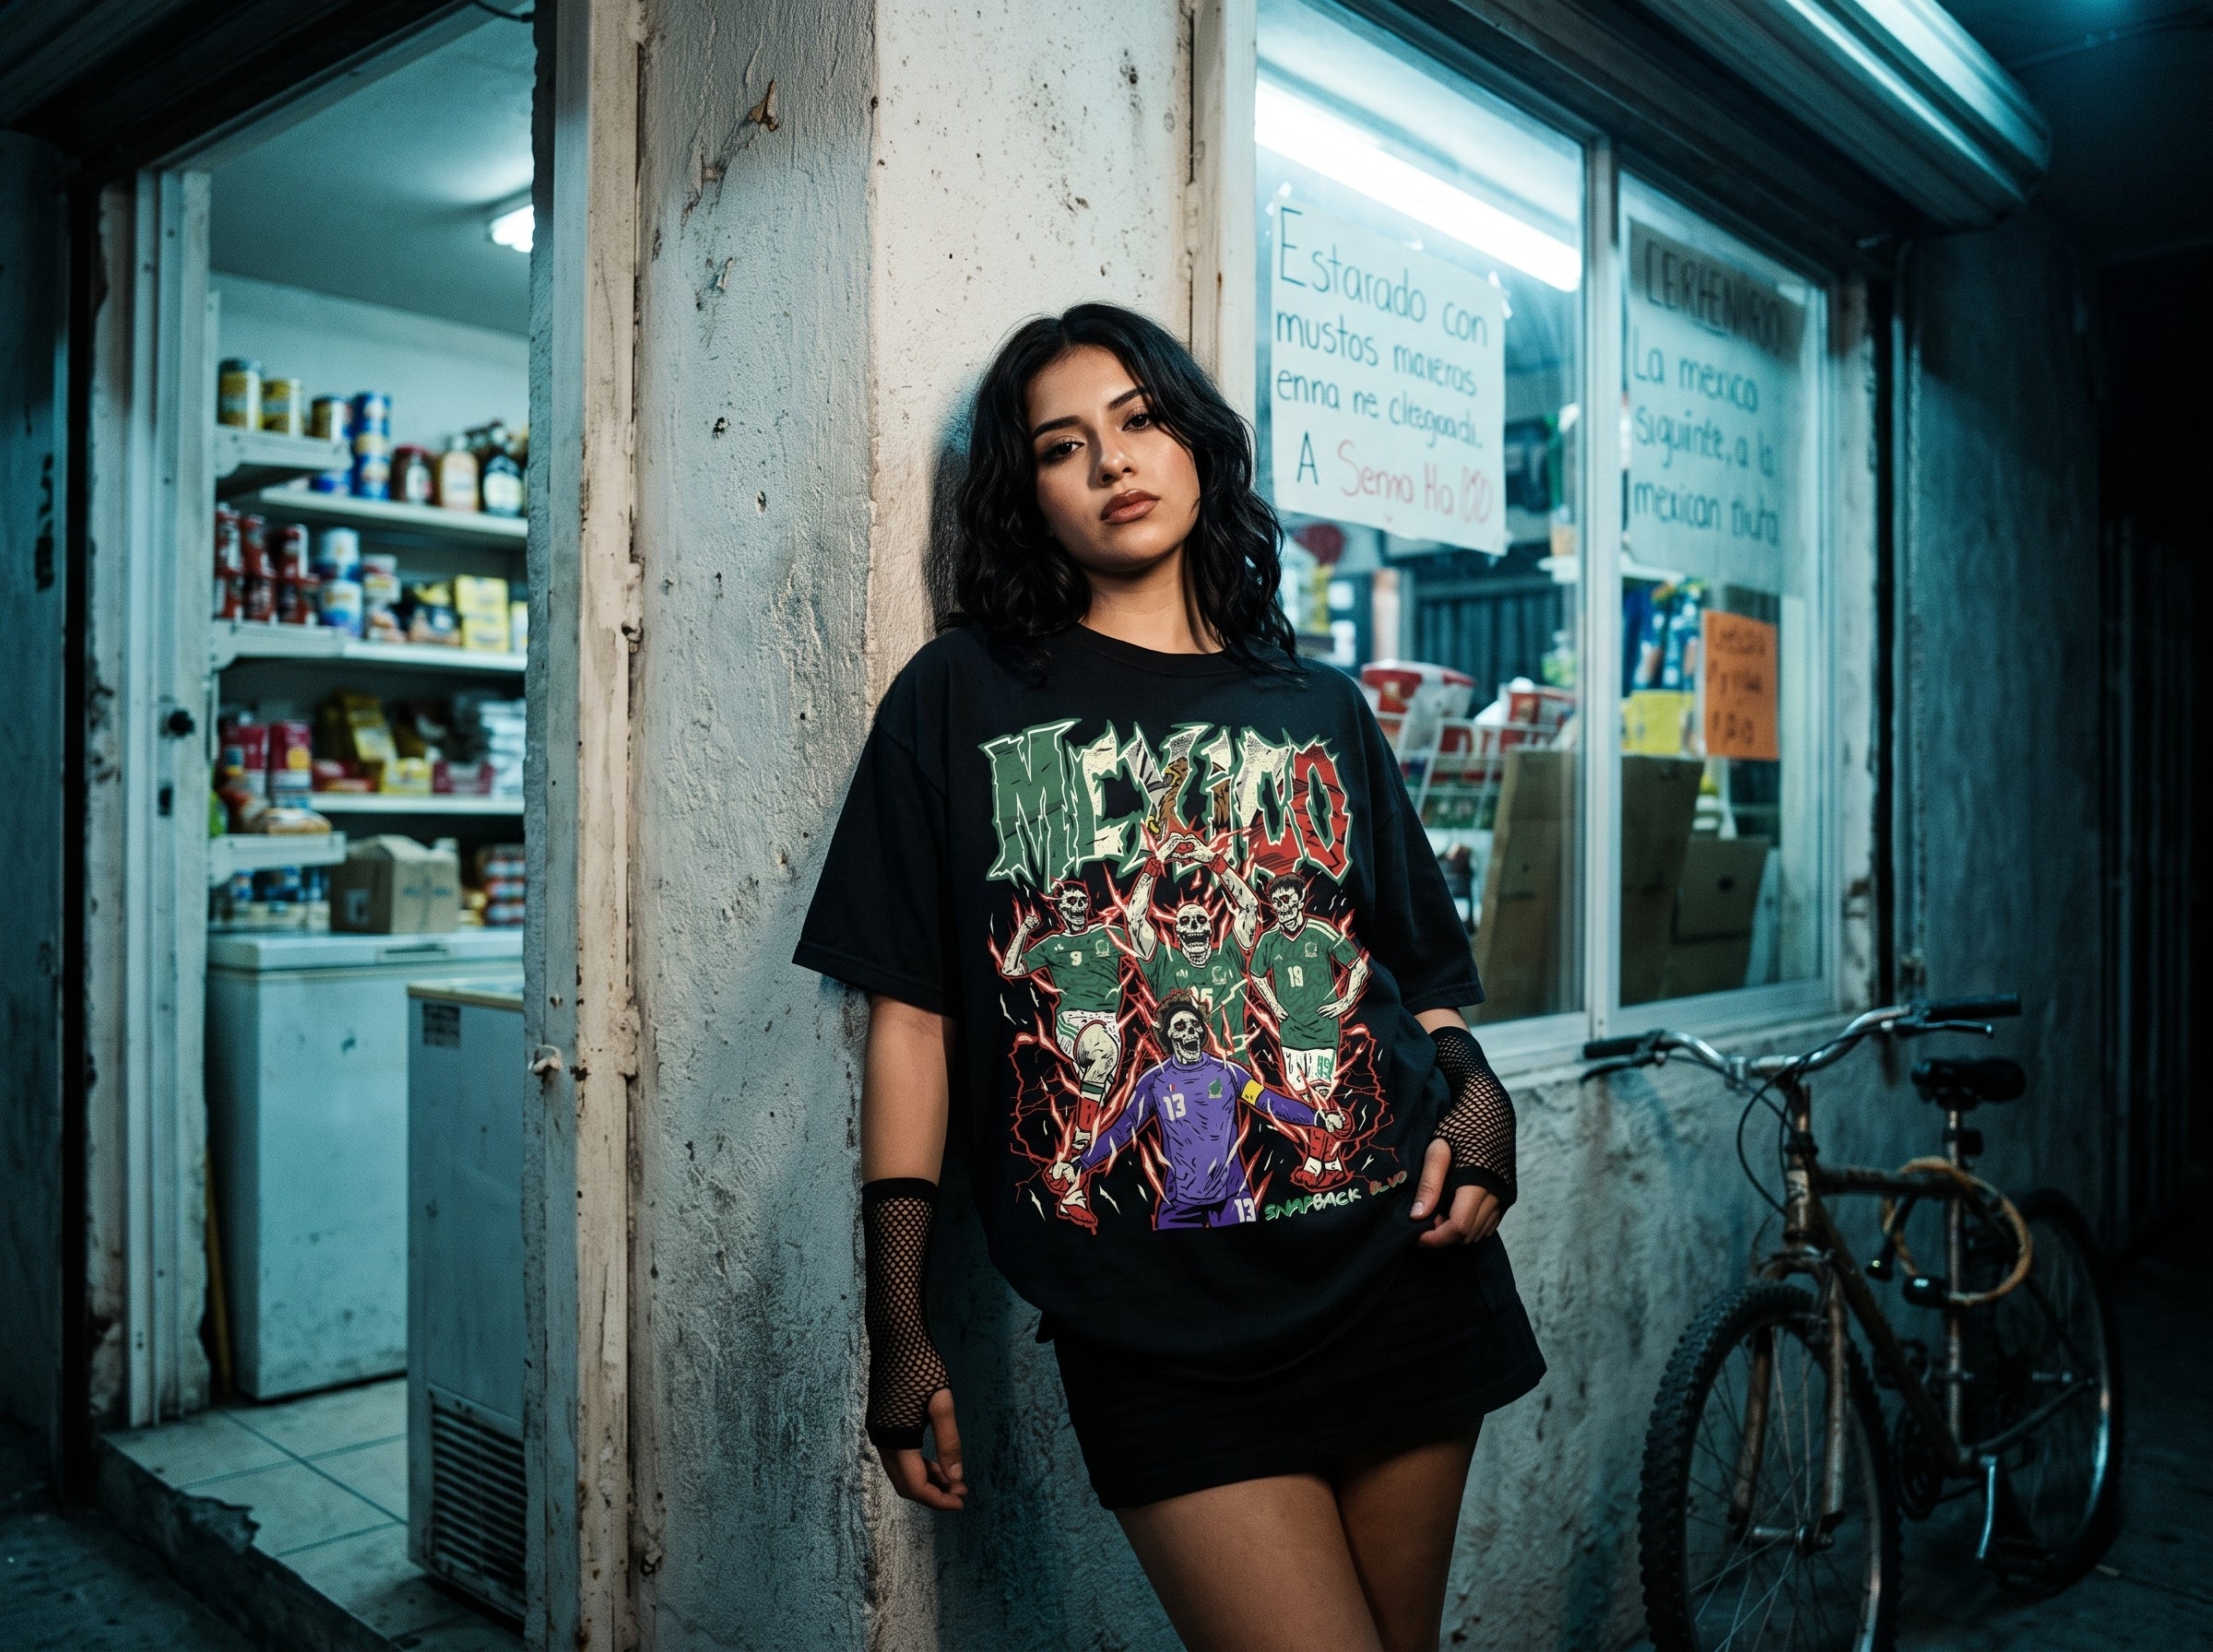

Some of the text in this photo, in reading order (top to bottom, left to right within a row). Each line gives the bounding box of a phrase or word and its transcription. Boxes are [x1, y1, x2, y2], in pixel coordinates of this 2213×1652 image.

[1280, 206, 1489, 348] Estarado con
[1276, 310, 1379, 368] mustos
[1632, 325, 1665, 384] La
[1276, 369, 1340, 410] enna
[1352, 391, 1380, 419] ne
[1296, 430, 1320, 487] A
[1070, 951, 1083, 966] 9
[1287, 965, 1304, 987] 19
[1163, 1092, 1187, 1122] 13
[1234, 1198, 1257, 1223] 13
